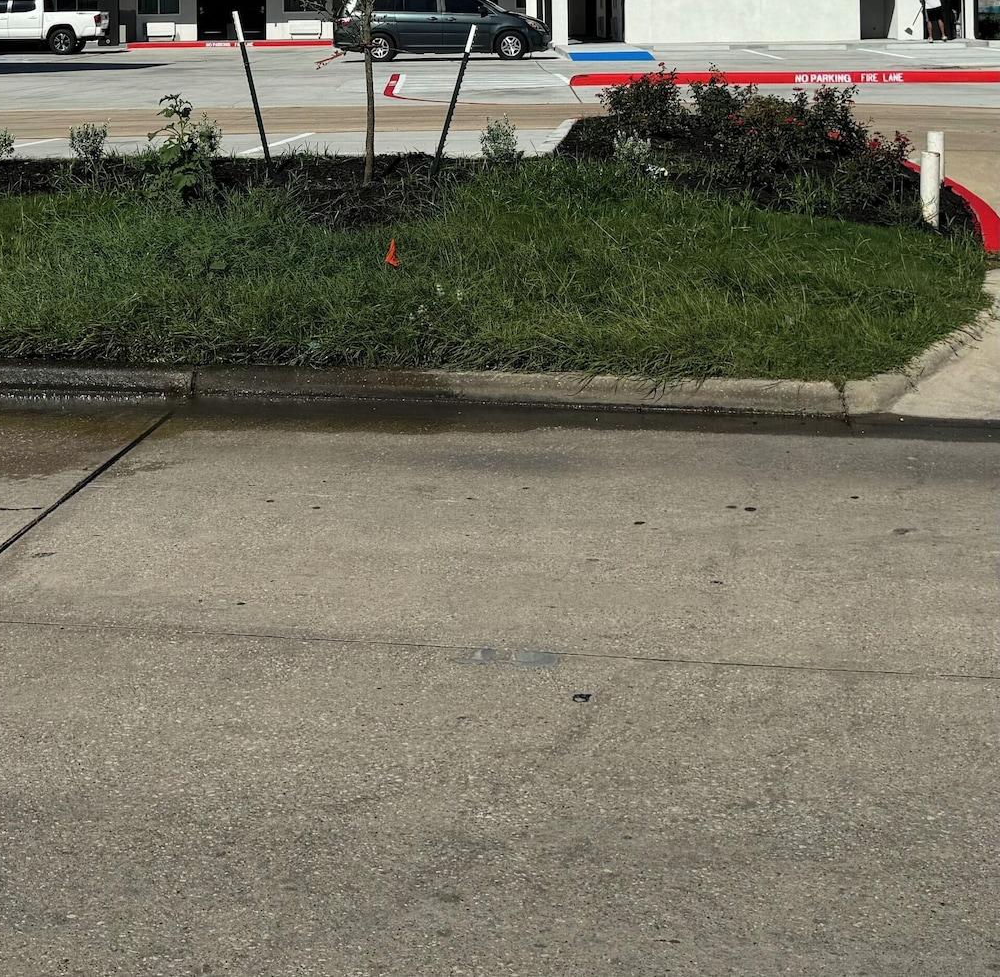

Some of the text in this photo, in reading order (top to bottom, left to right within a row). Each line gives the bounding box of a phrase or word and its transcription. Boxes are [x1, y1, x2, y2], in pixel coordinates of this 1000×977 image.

[794, 72, 905, 83] NO PARKING FIRE LANE
